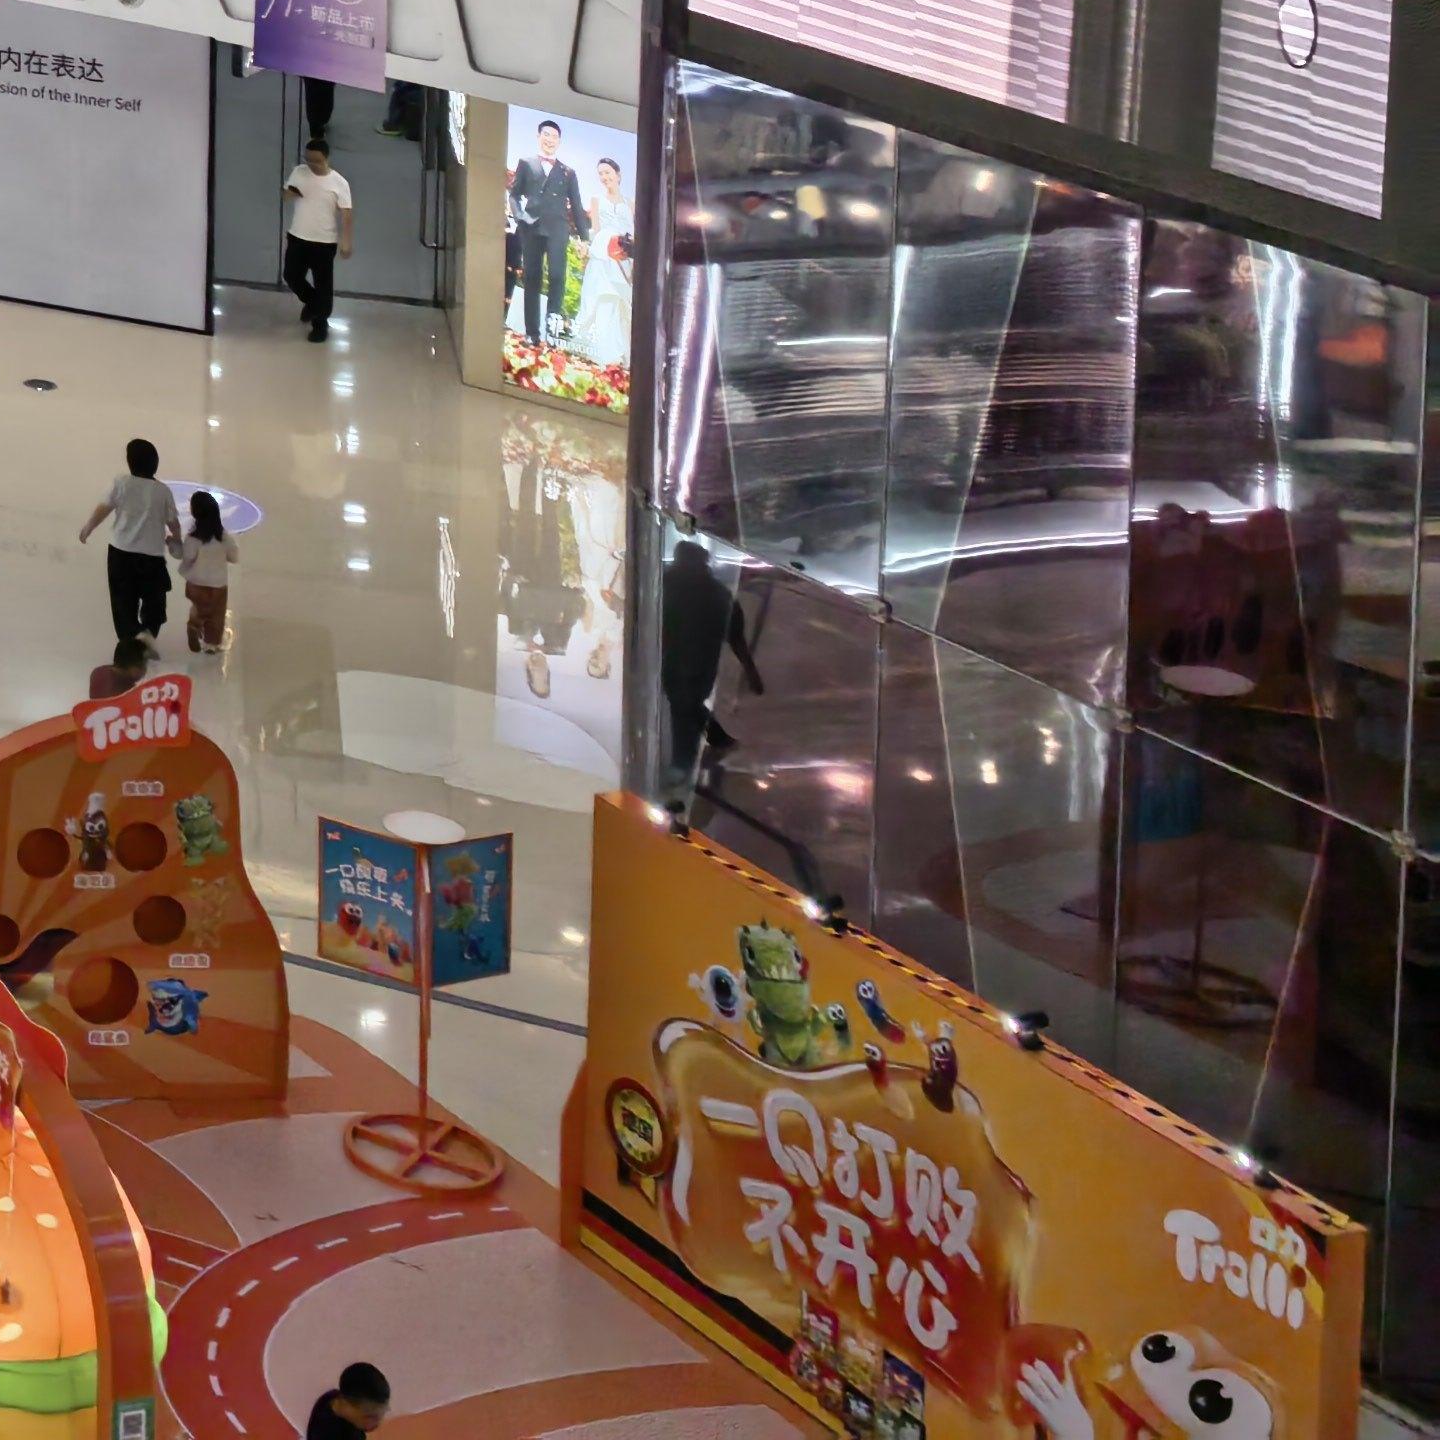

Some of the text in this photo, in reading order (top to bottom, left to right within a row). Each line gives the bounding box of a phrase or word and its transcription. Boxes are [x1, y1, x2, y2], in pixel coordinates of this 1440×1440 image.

[31, 85, 46, 100] of
[48, 88, 71, 103] the
[74, 92, 111, 109] Inner
[114, 96, 142, 113] Self
[83, 706, 180, 750] Trolli
[739, 1176, 959, 1350] 不开心
[1164, 1209, 1305, 1330] Trolli
